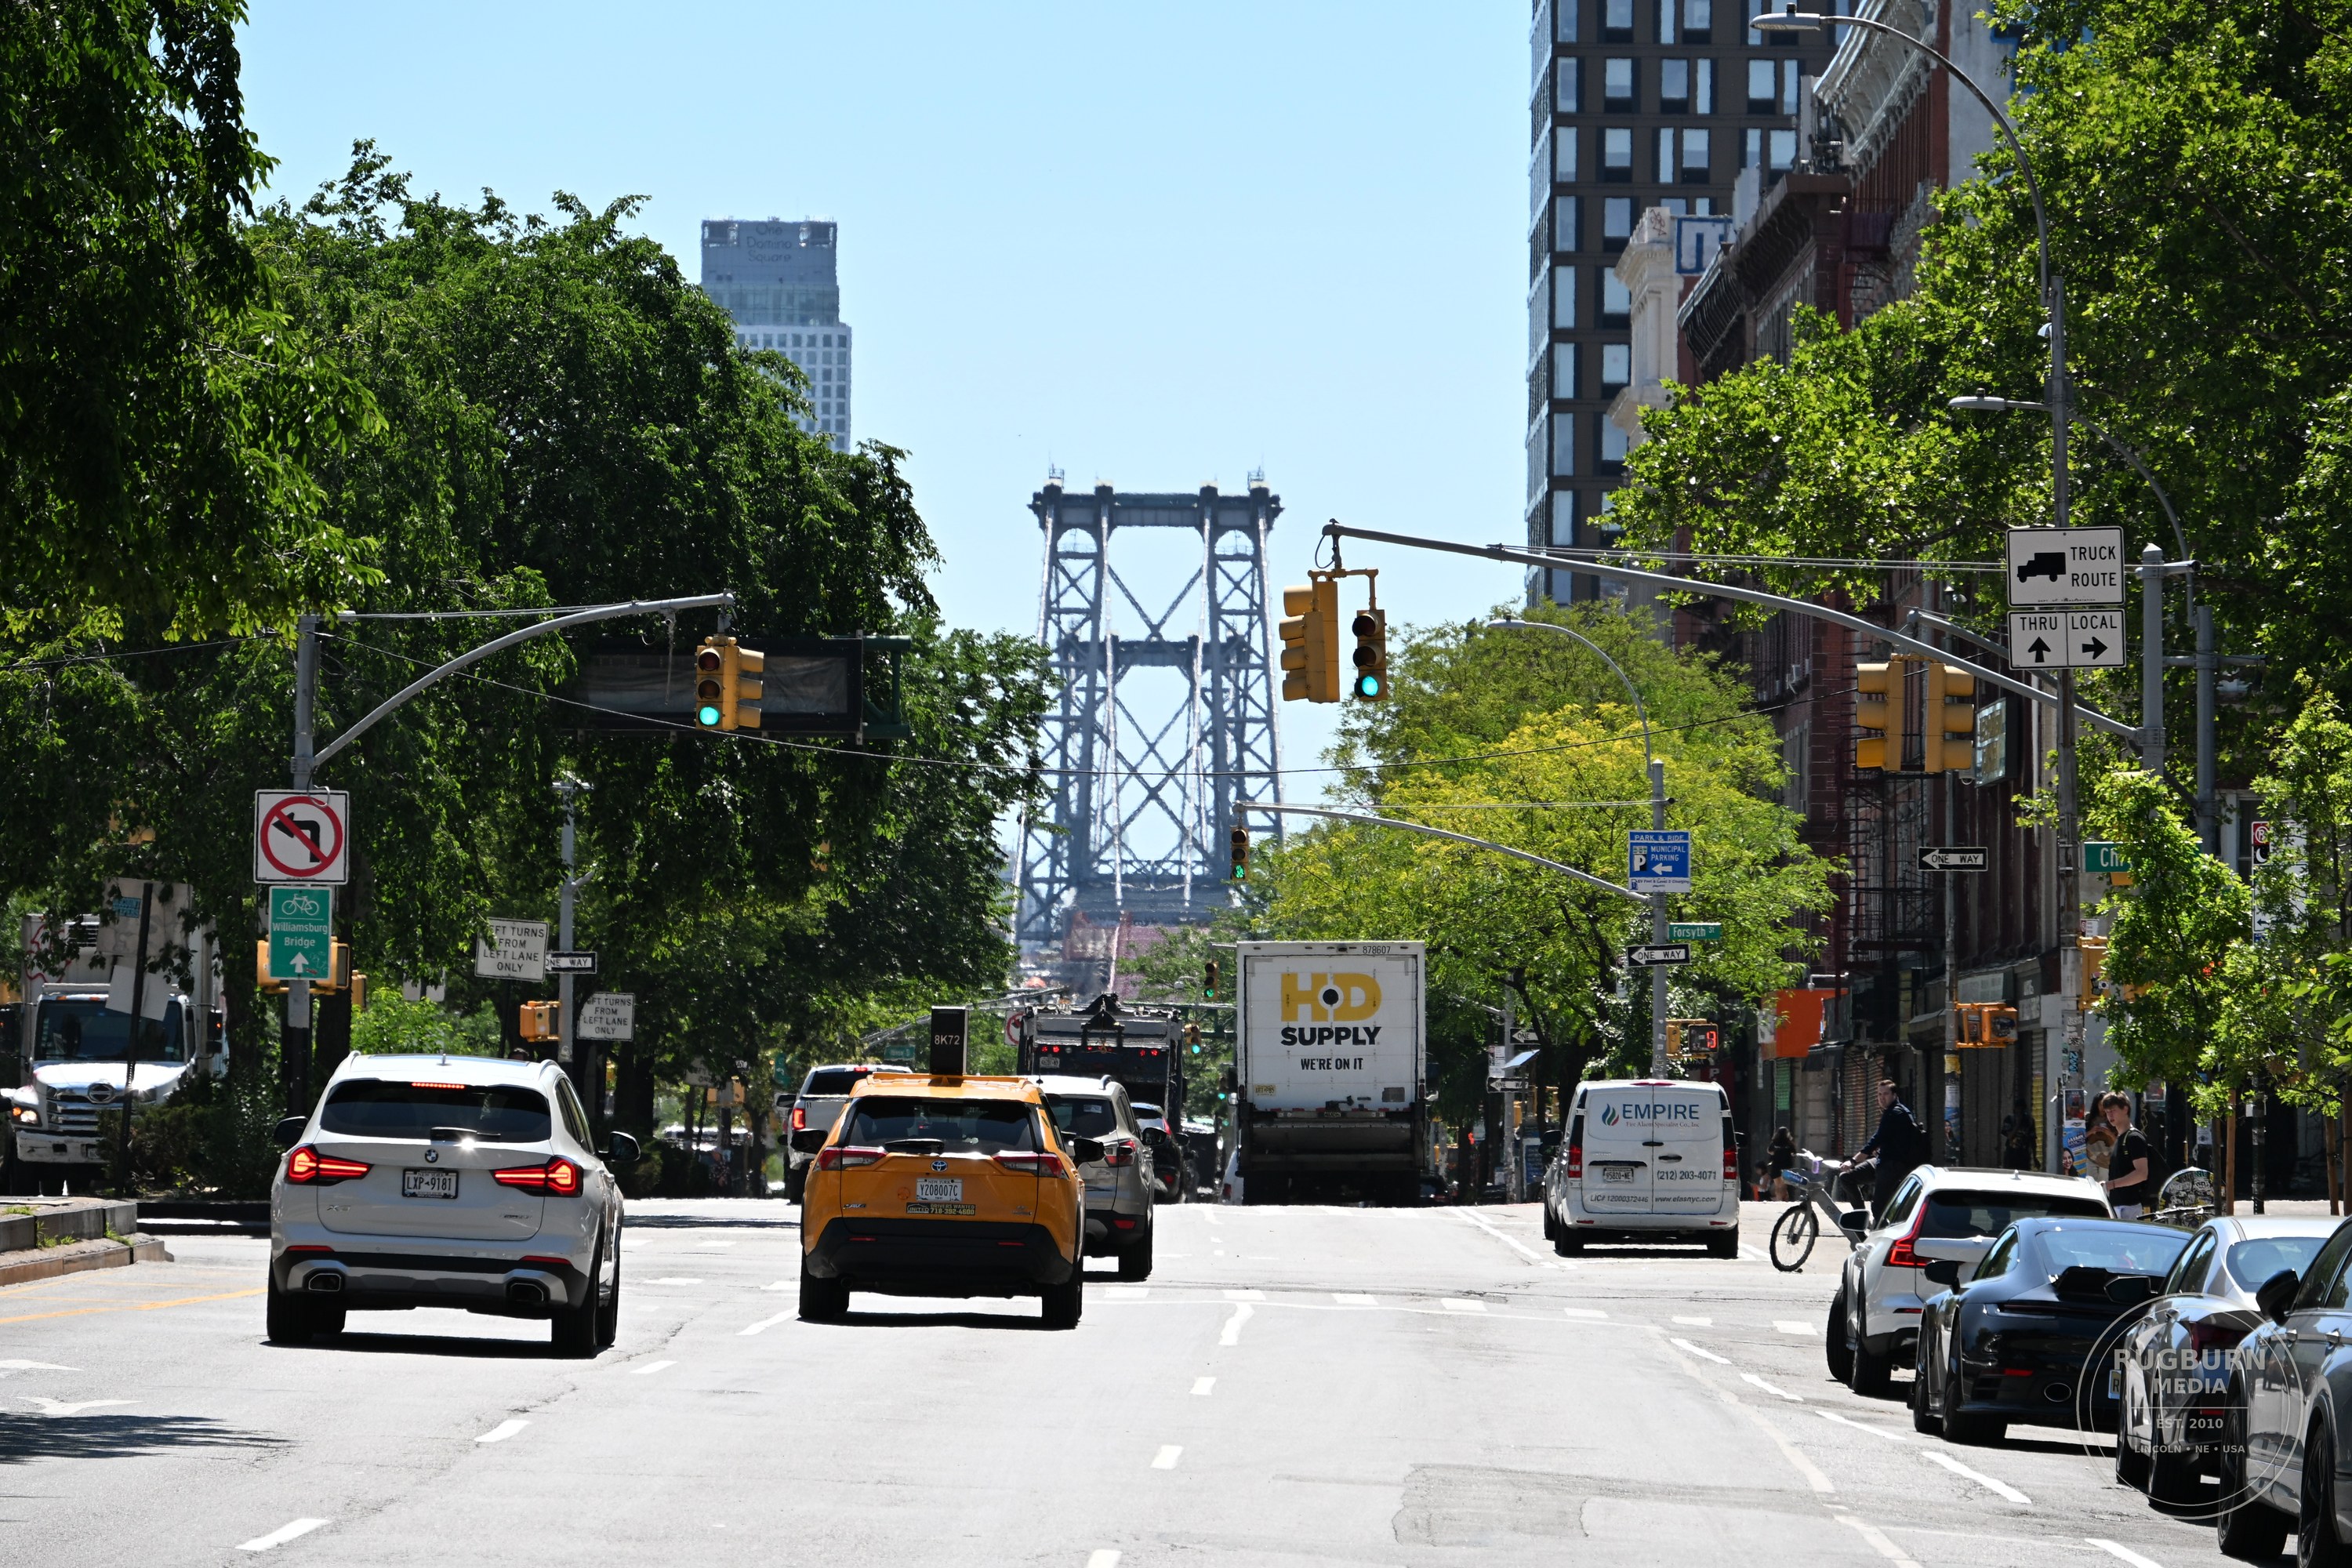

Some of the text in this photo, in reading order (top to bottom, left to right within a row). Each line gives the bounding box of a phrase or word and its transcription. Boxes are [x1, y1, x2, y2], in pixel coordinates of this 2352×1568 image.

[755, 222, 782, 236] One
[746, 236, 792, 249] Domino
[748, 249, 791, 263] Square
[2071, 546, 2117, 561] TRUCK
[2071, 572, 2117, 587] ROUTE
[2020, 616, 2058, 631] THRU
[2071, 615, 2118, 630] LOCAL
[1932, 854, 1980, 864] ONE WAY
[272, 922, 328, 935] Williamsburg
[511, 927, 545, 938] TURNS
[1673, 927, 1706, 938] Forsyth
[284, 936, 315, 948] Bridge
[498, 938, 526, 949] FROM
[483, 949, 539, 962] LEFT LANE
[1363, 946, 1391, 955] 878607
[1638, 950, 1682, 960] ONE WAY
[496, 961, 523, 973] ONLY
[569, 958, 588, 967] WAY
[604, 998, 632, 1007] TURNS
[1280, 972, 1382, 1022] HD
[594, 1007, 618, 1015] FROM
[583, 1016, 628, 1026] LEFT LANE
[594, 1026, 616, 1035] ONLY
[1280, 1026, 1382, 1046] SUPPLY
[934, 1035, 960, 1045] 8K72
[1300, 1058, 1363, 1070] WE'RE ON IT
[1622, 1104, 1700, 1120] EMPIRE
[1657, 1170, 1716, 1181] (212) 203-4071
[920, 1184, 958, 1196] Y208007C
